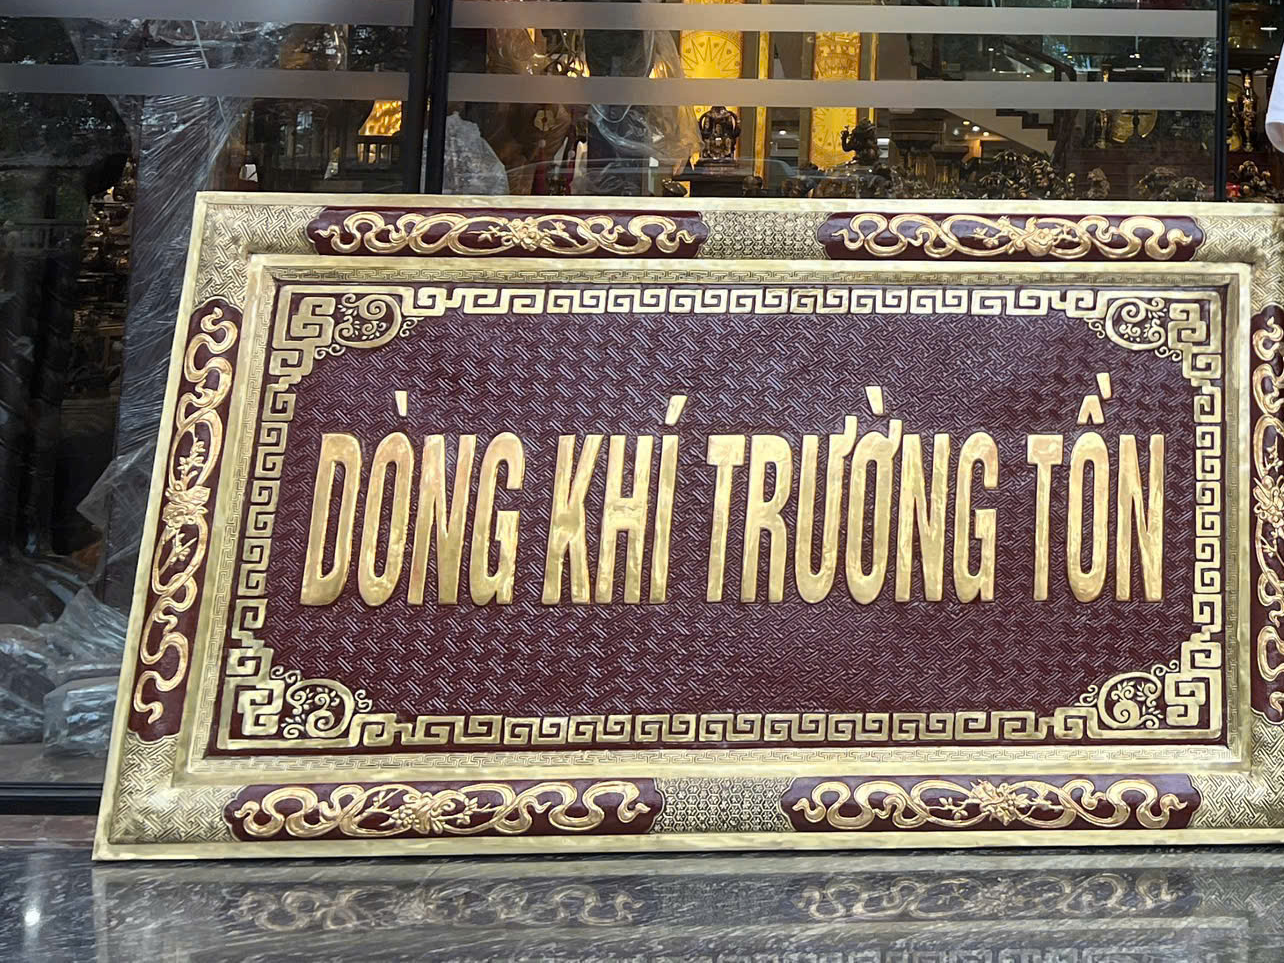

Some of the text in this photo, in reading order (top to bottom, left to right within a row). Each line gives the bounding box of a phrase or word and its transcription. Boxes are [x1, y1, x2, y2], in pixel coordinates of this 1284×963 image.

[301, 372, 1165, 607] DÒNG KHÍ TRƯỜNG TỒN
